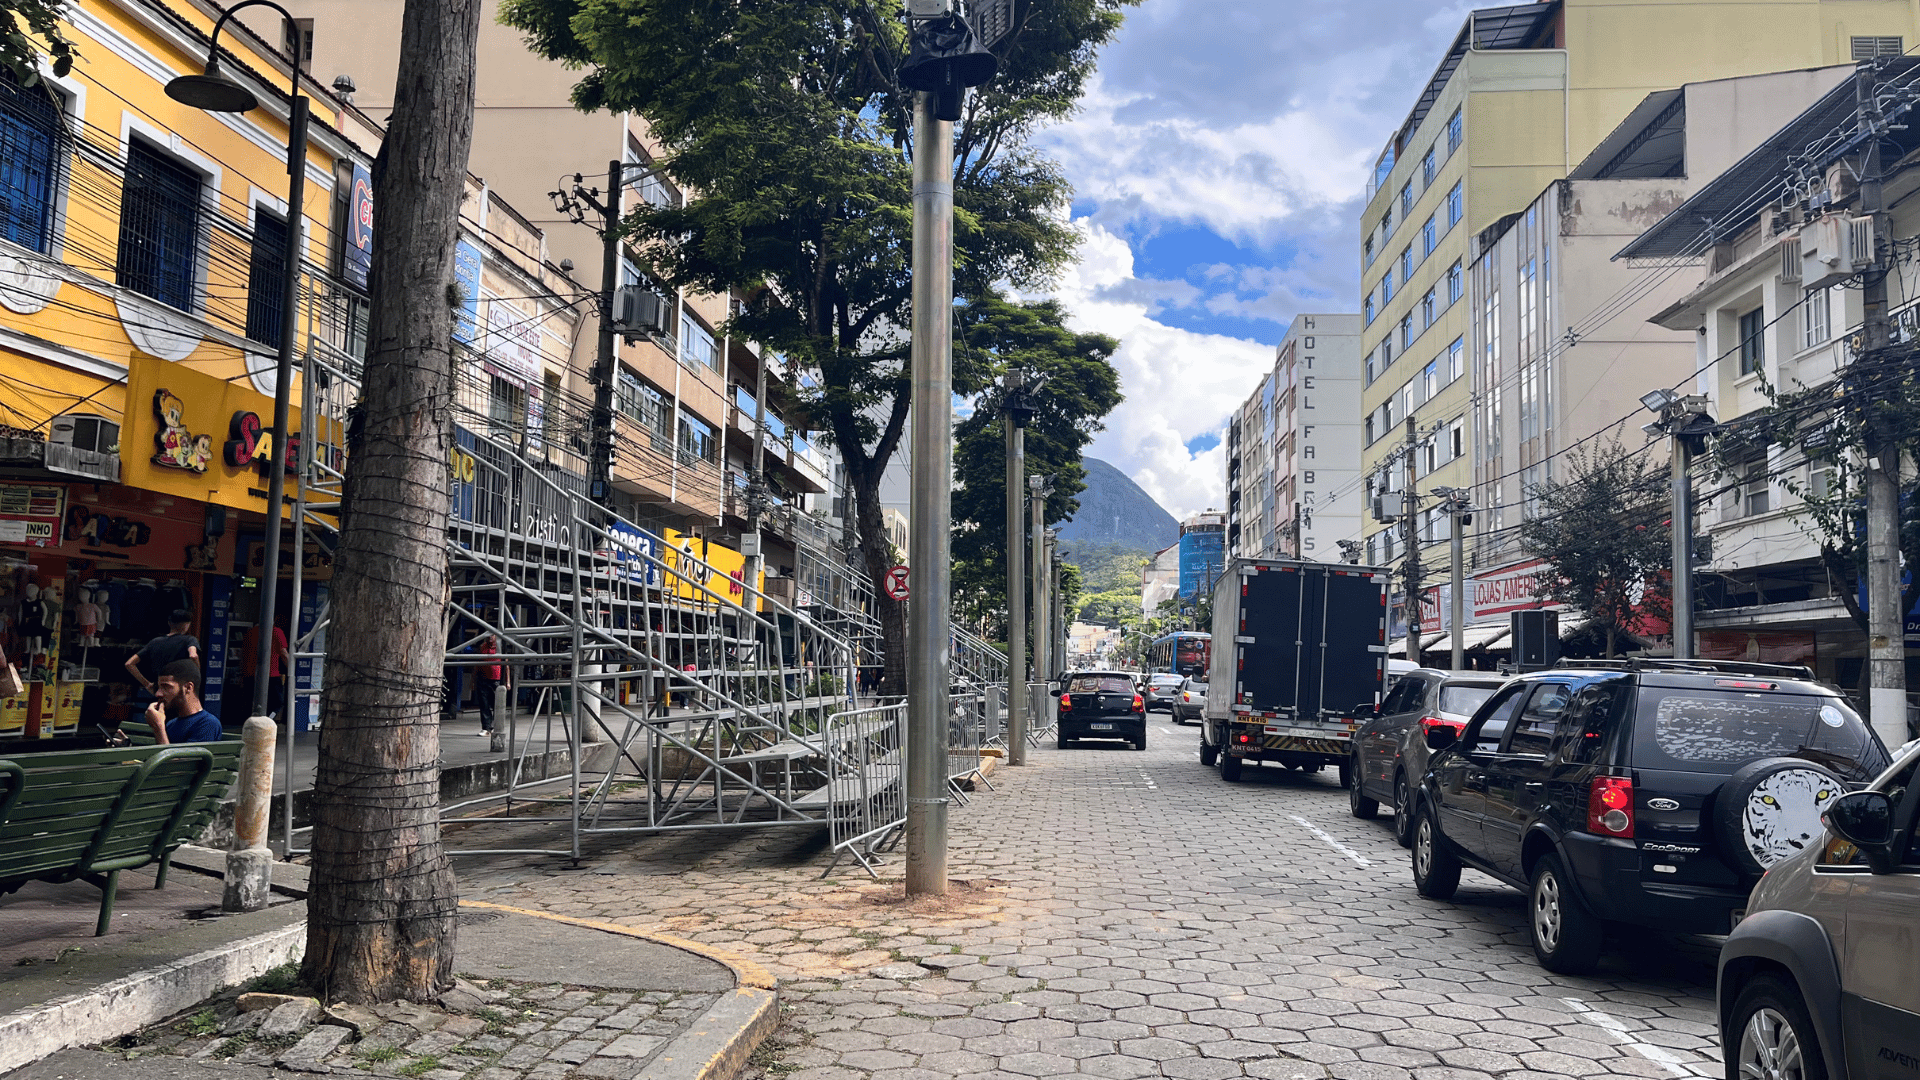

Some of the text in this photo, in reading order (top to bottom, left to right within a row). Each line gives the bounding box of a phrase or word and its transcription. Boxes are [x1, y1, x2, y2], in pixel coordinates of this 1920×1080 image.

[1304, 316, 1315, 410] HOTEL
[1474, 580, 1501, 606] LOJAS
[1655, 800, 1673, 809] Ford
